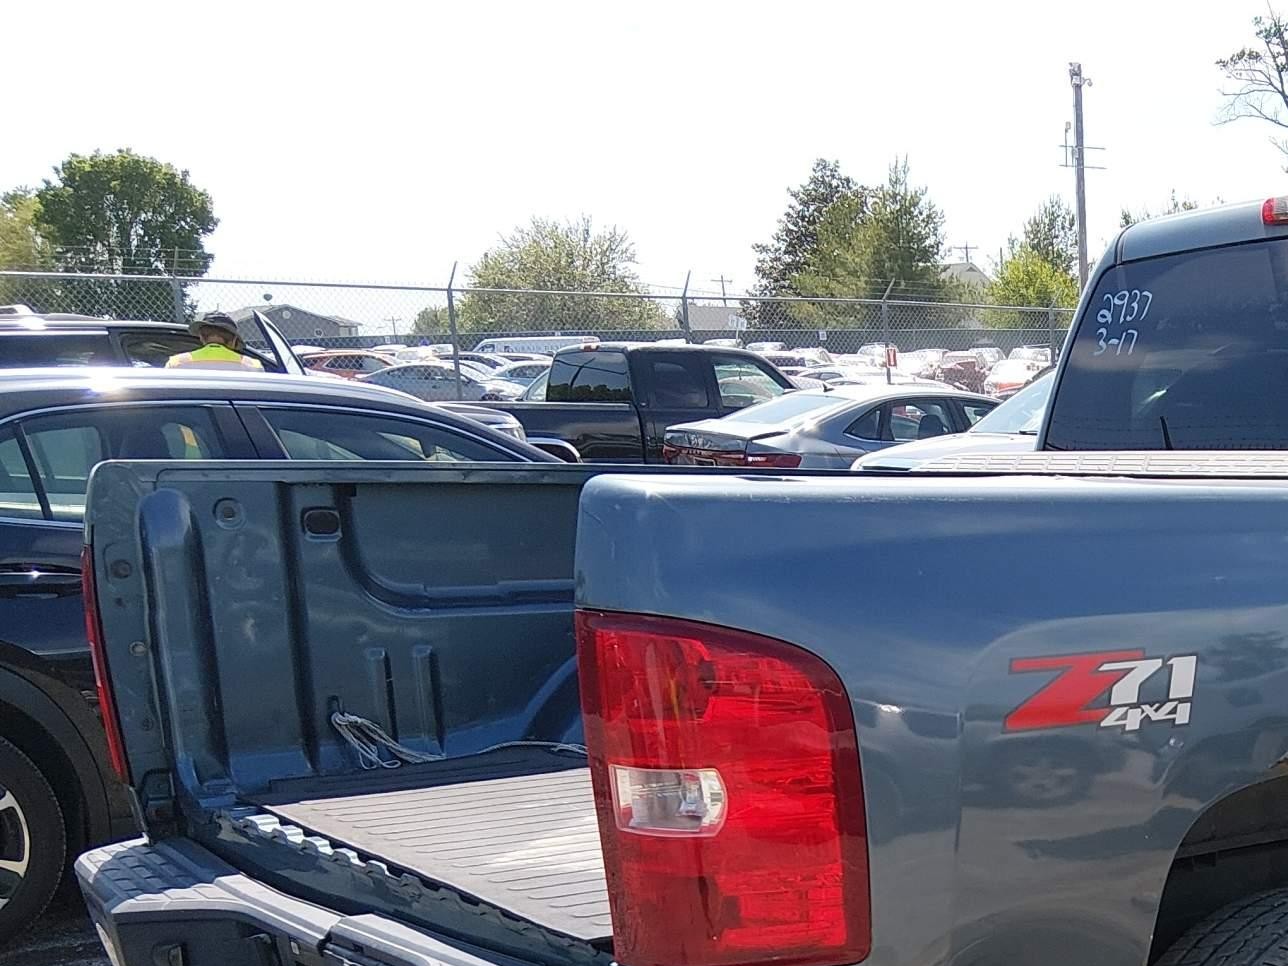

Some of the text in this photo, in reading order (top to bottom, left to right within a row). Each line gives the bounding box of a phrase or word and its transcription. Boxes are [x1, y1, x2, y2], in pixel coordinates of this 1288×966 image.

[1097, 290, 1153, 324] 2937
[1094, 328, 1138, 356] 3-17
[1003, 648, 1198, 732] Z71
